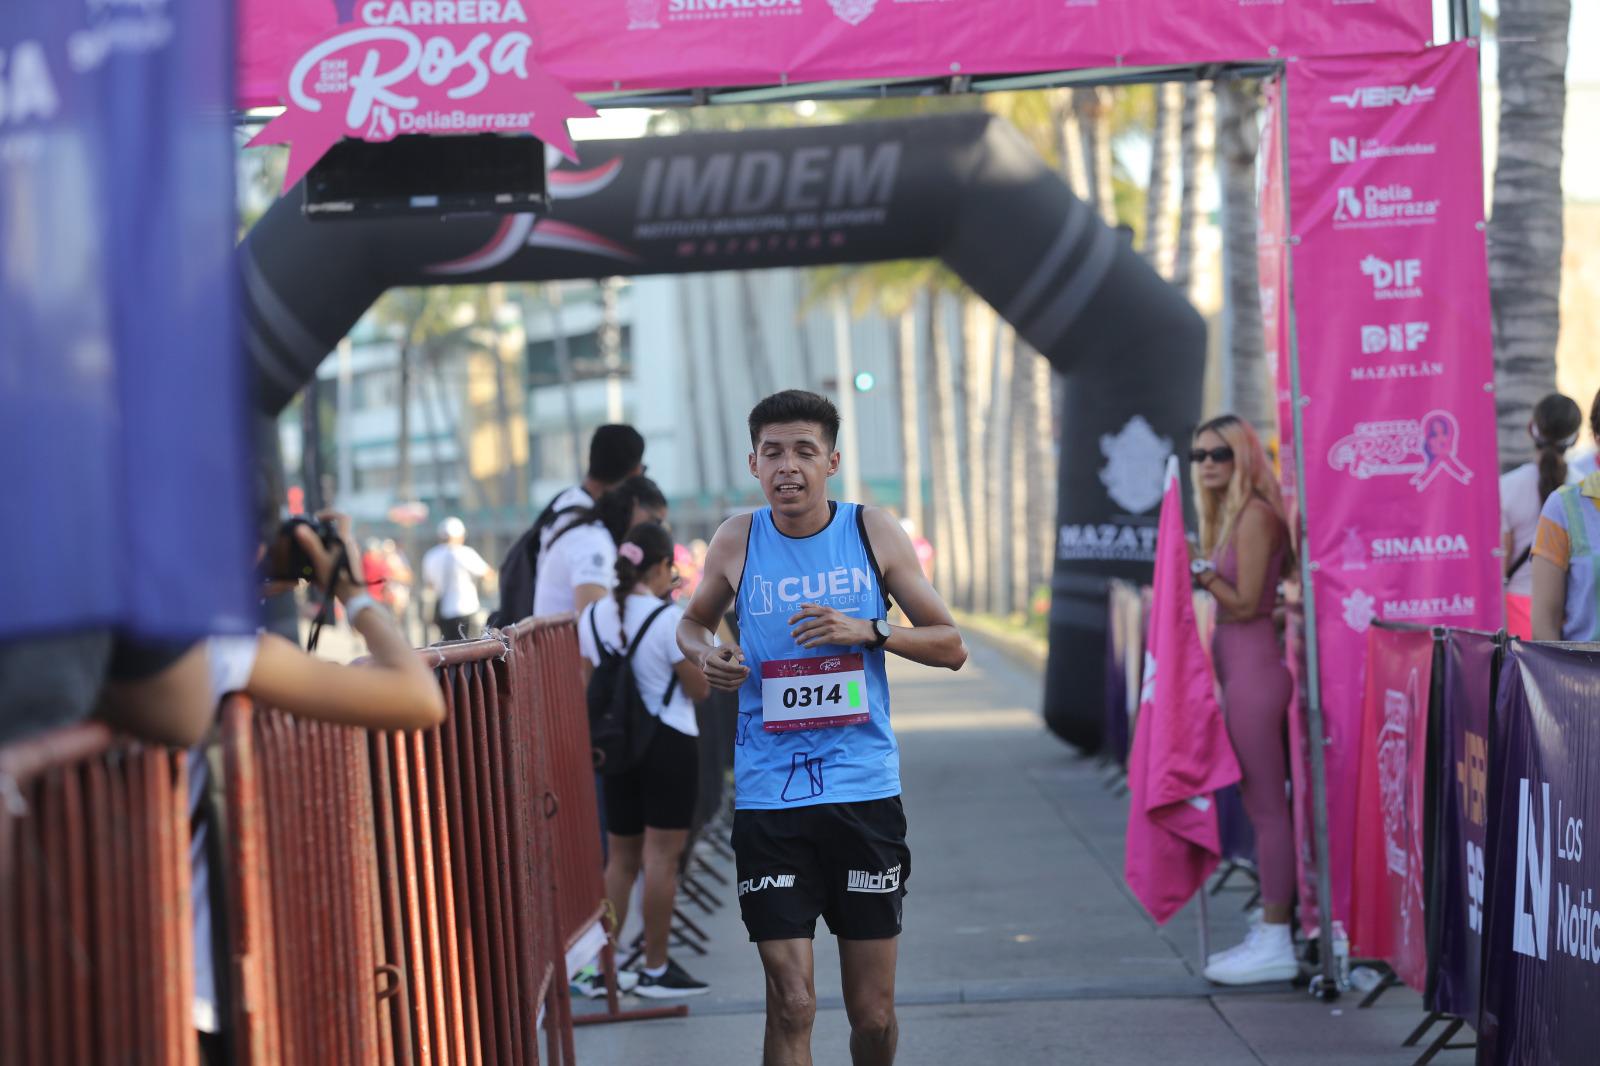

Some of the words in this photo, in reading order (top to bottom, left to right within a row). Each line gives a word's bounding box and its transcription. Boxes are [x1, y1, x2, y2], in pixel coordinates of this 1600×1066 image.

[362, 0, 527, 26] CARRERA
[289, 26, 533, 129] Rosa
[636, 141, 902, 219] IMDEM
[1364, 184, 1413, 201] Delia
[1372, 257, 1421, 289] DIF
[1360, 322, 1430, 354] DIF
[1350, 361, 1444, 380] MAZATLÁN
[1059, 524, 1159, 549] MAZAT
[1372, 535, 1469, 558] SINALOA
[777, 566, 872, 602] CUÉN
[779, 593, 873, 612] LABRATORIOS
[1383, 594, 1475, 614] MAZATLÁN
[783, 683, 842, 709] 0314
[1557, 799, 1584, 863] Los
